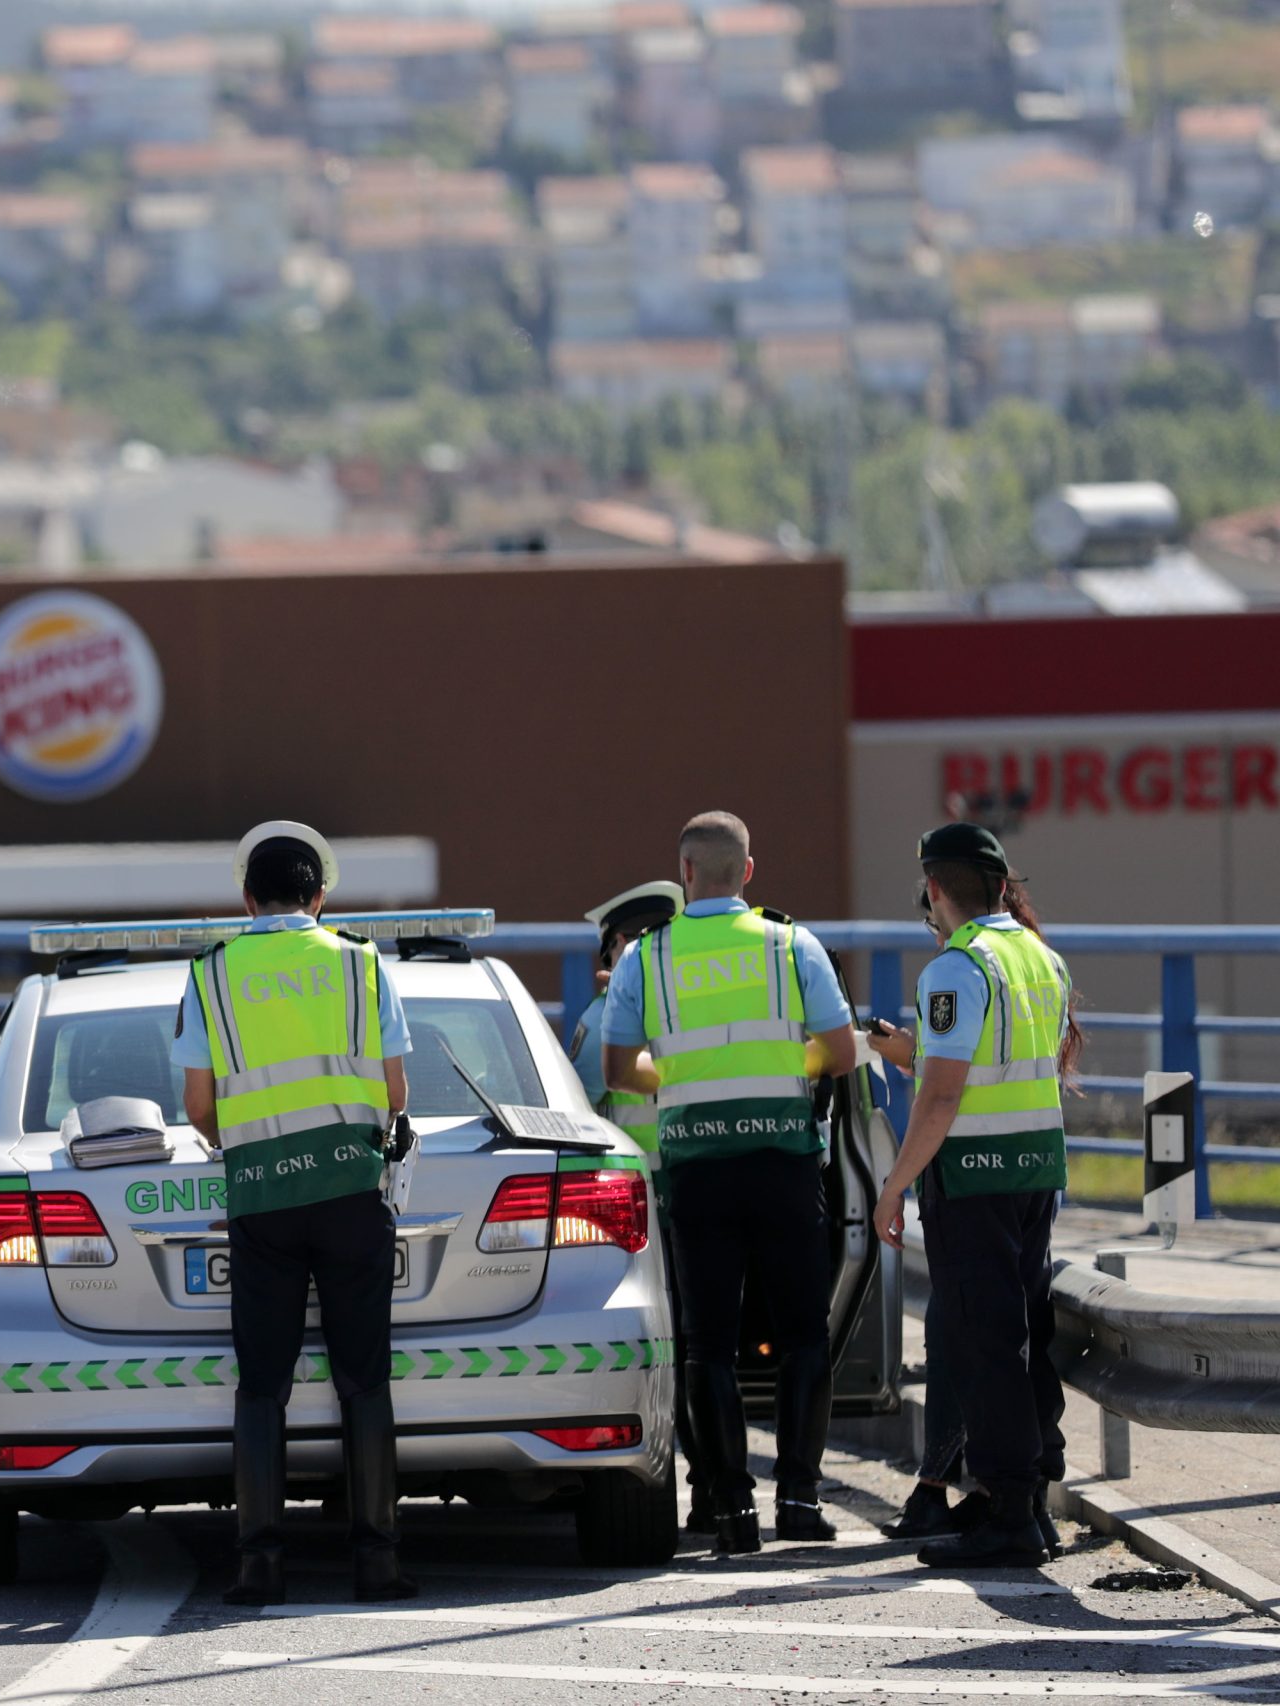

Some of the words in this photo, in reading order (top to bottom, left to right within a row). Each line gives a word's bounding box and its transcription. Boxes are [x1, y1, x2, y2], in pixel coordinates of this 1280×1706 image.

[942, 742, 1279, 820] BURGER
[241, 964, 338, 1003] GNR
[677, 951, 764, 991] GNR
[693, 1120, 728, 1136] GNR
[736, 1118, 778, 1133] GNR
[235, 1165, 264, 1183] GNR
[276, 1154, 318, 1175] GNR
[961, 1153, 1005, 1168] GNR
[1018, 1152, 1056, 1168] GNR
[125, 1177, 228, 1214] GNR
[66, 1279, 117, 1290] TOYOTA
